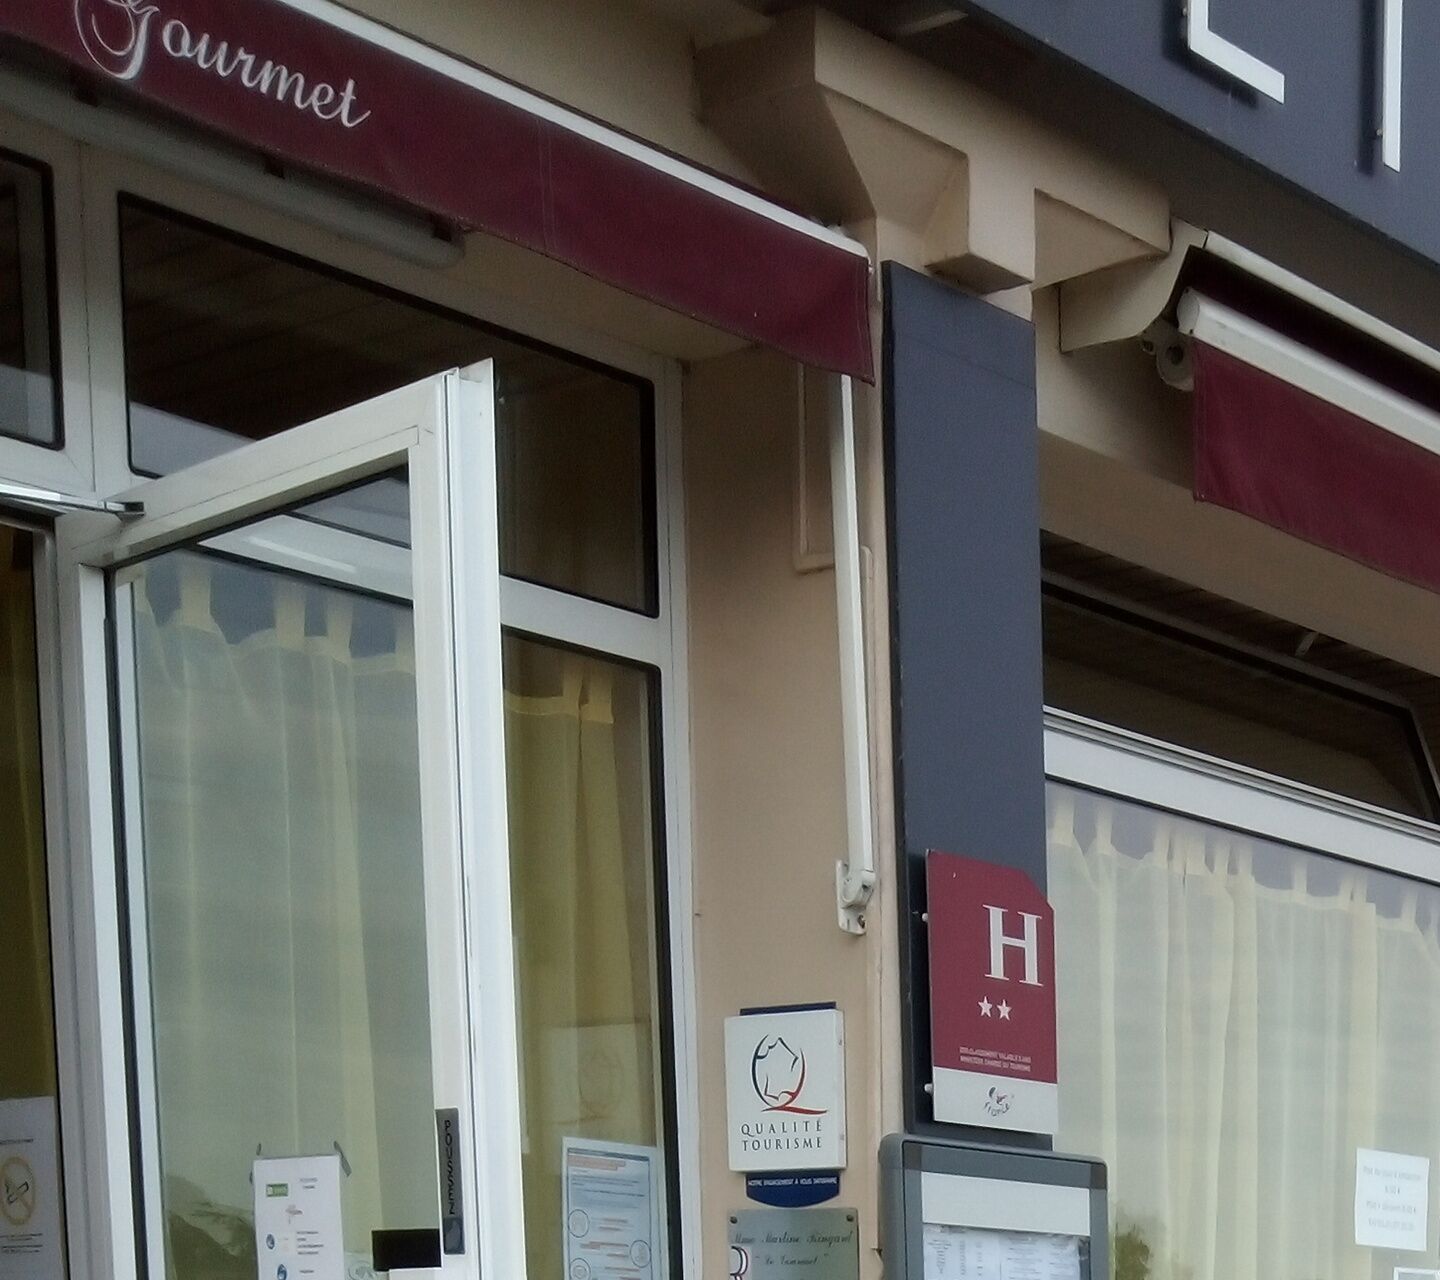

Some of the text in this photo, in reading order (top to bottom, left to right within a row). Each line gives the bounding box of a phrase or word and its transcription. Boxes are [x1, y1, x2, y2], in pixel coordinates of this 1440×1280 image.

[74, 0, 371, 128] Gourmet
[982, 903, 1044, 987] H
[443, 1118, 456, 1216] POUSSEZ
[742, 1136, 822, 1152] TOURISME
